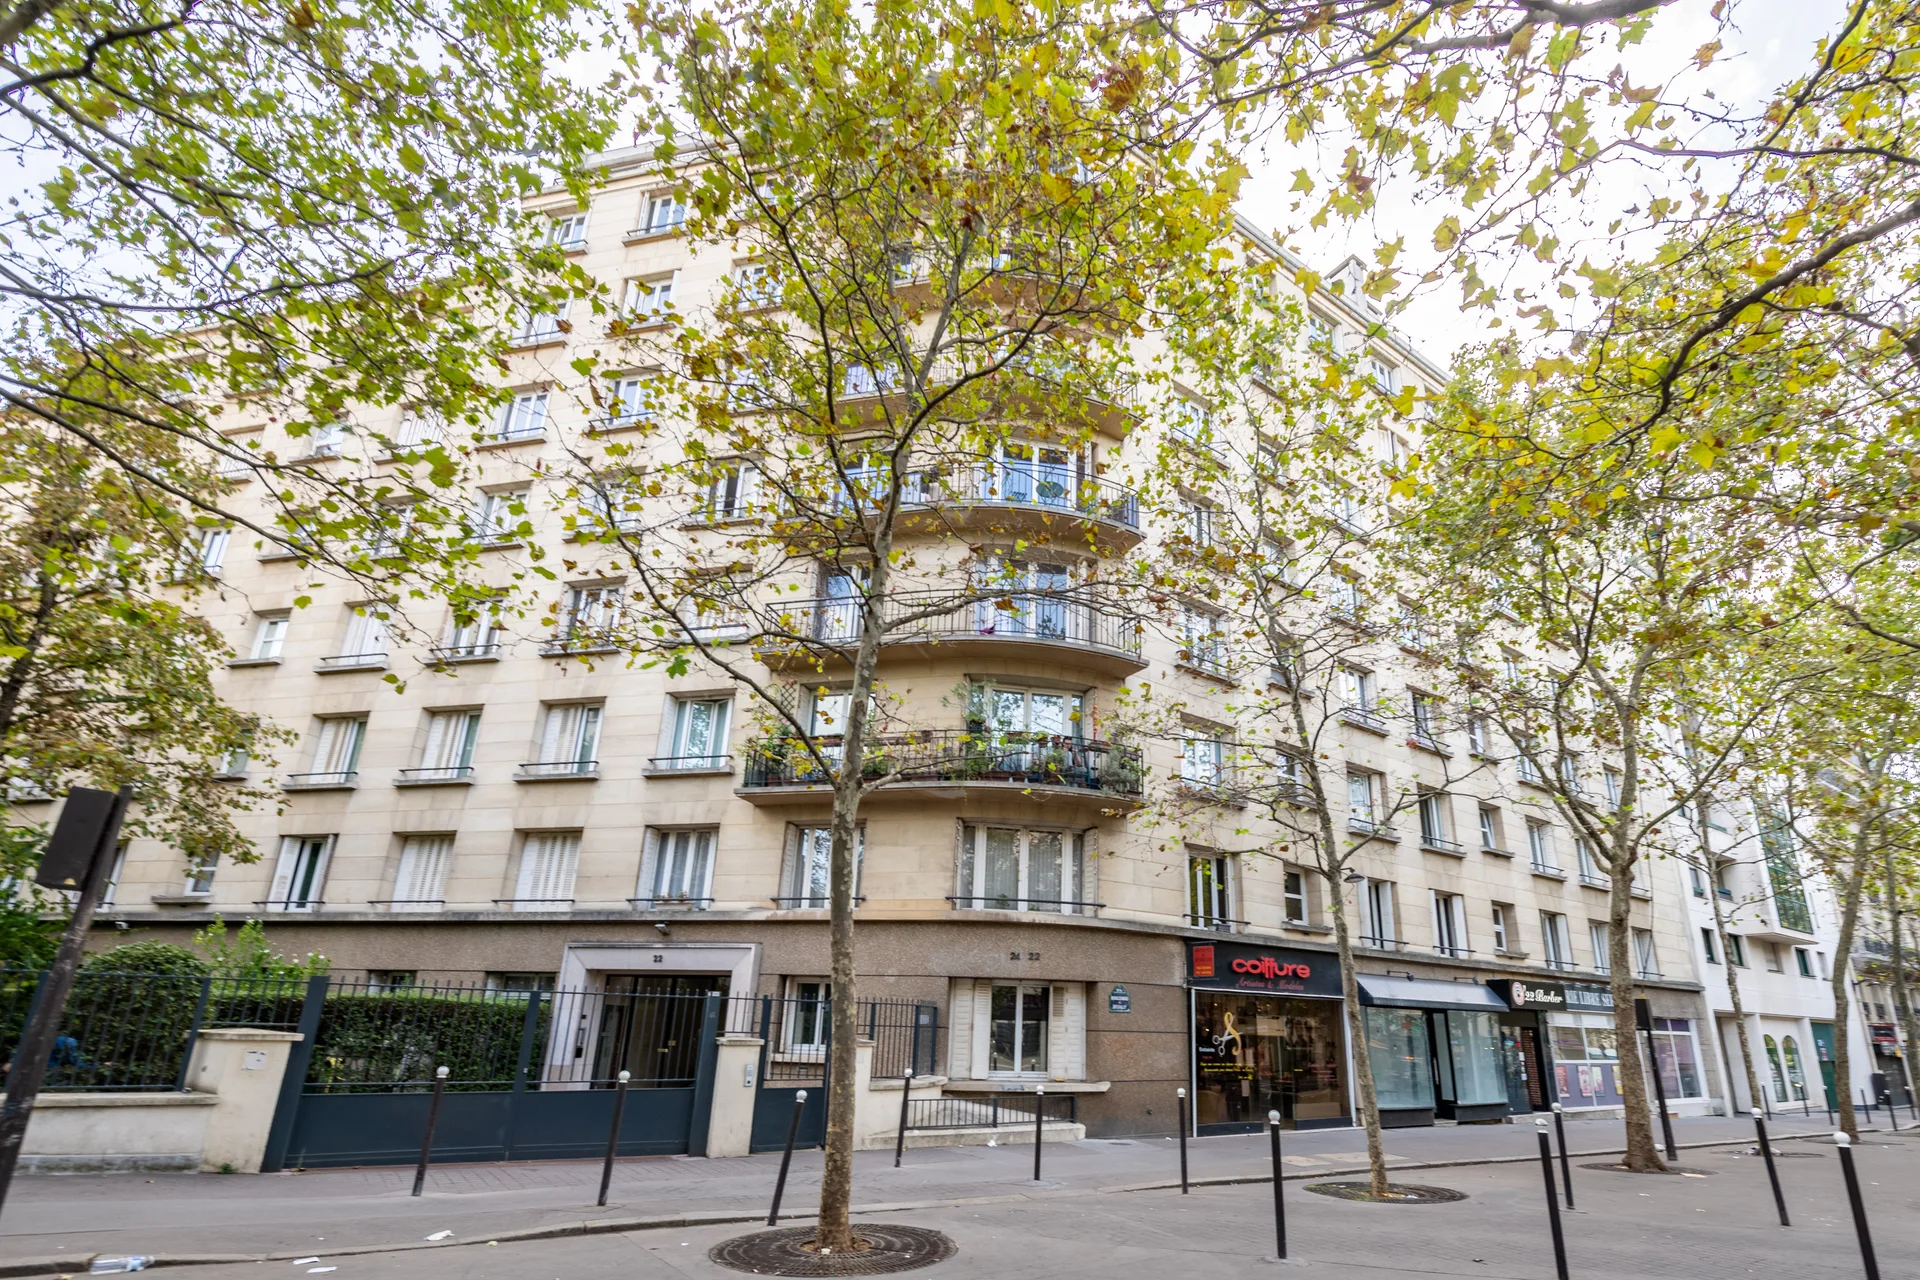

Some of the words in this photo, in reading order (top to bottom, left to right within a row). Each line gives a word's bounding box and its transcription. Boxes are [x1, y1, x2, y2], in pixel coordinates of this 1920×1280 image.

[653, 954, 663, 963] 22
[1028, 952, 1040, 960] 22
[1232, 956, 1310, 979] coiffure
[1535, 989, 1563, 1003] Barber
